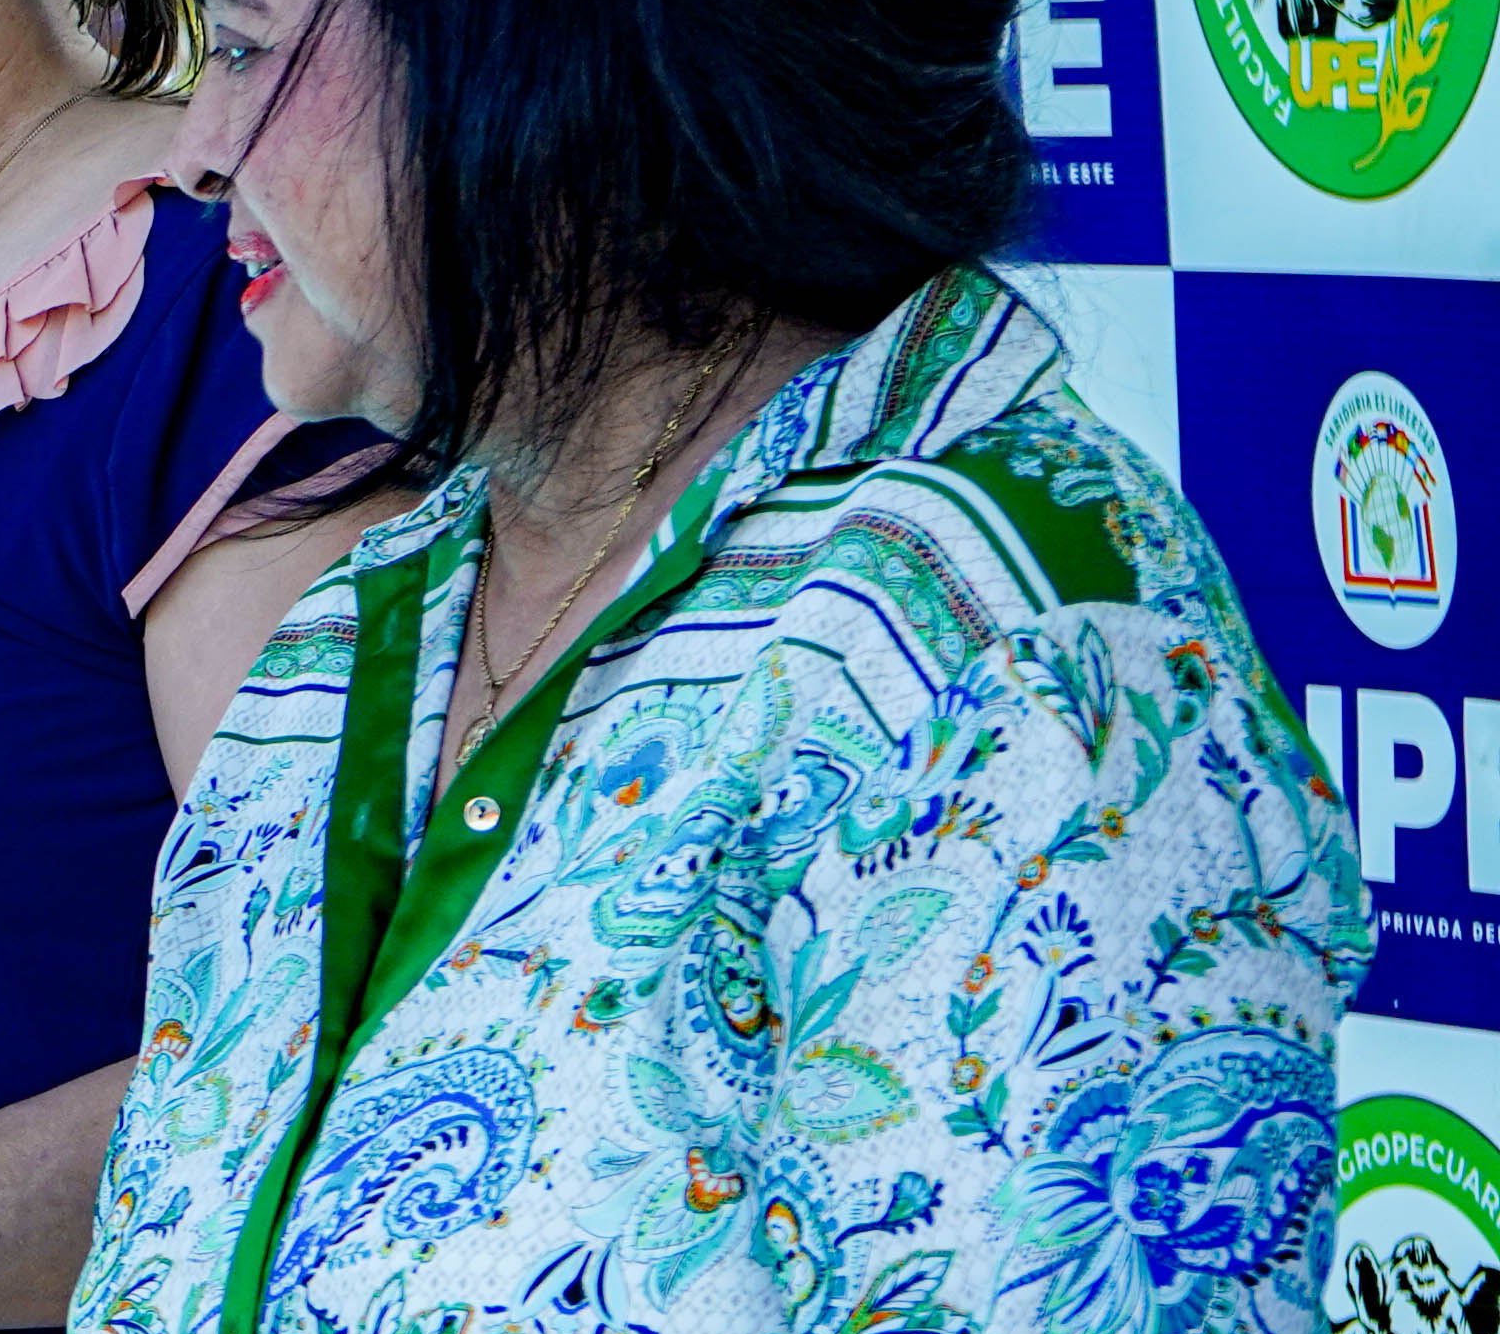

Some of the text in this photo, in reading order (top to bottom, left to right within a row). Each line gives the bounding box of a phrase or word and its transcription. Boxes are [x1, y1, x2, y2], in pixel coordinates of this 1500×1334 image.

[1289, 37, 1382, 112] UPE
[1068, 162, 1115, 185] ESTE
[1381, 910, 1462, 941] PRIVADA
[1334, 1130, 1500, 1230] GROPECUAR
